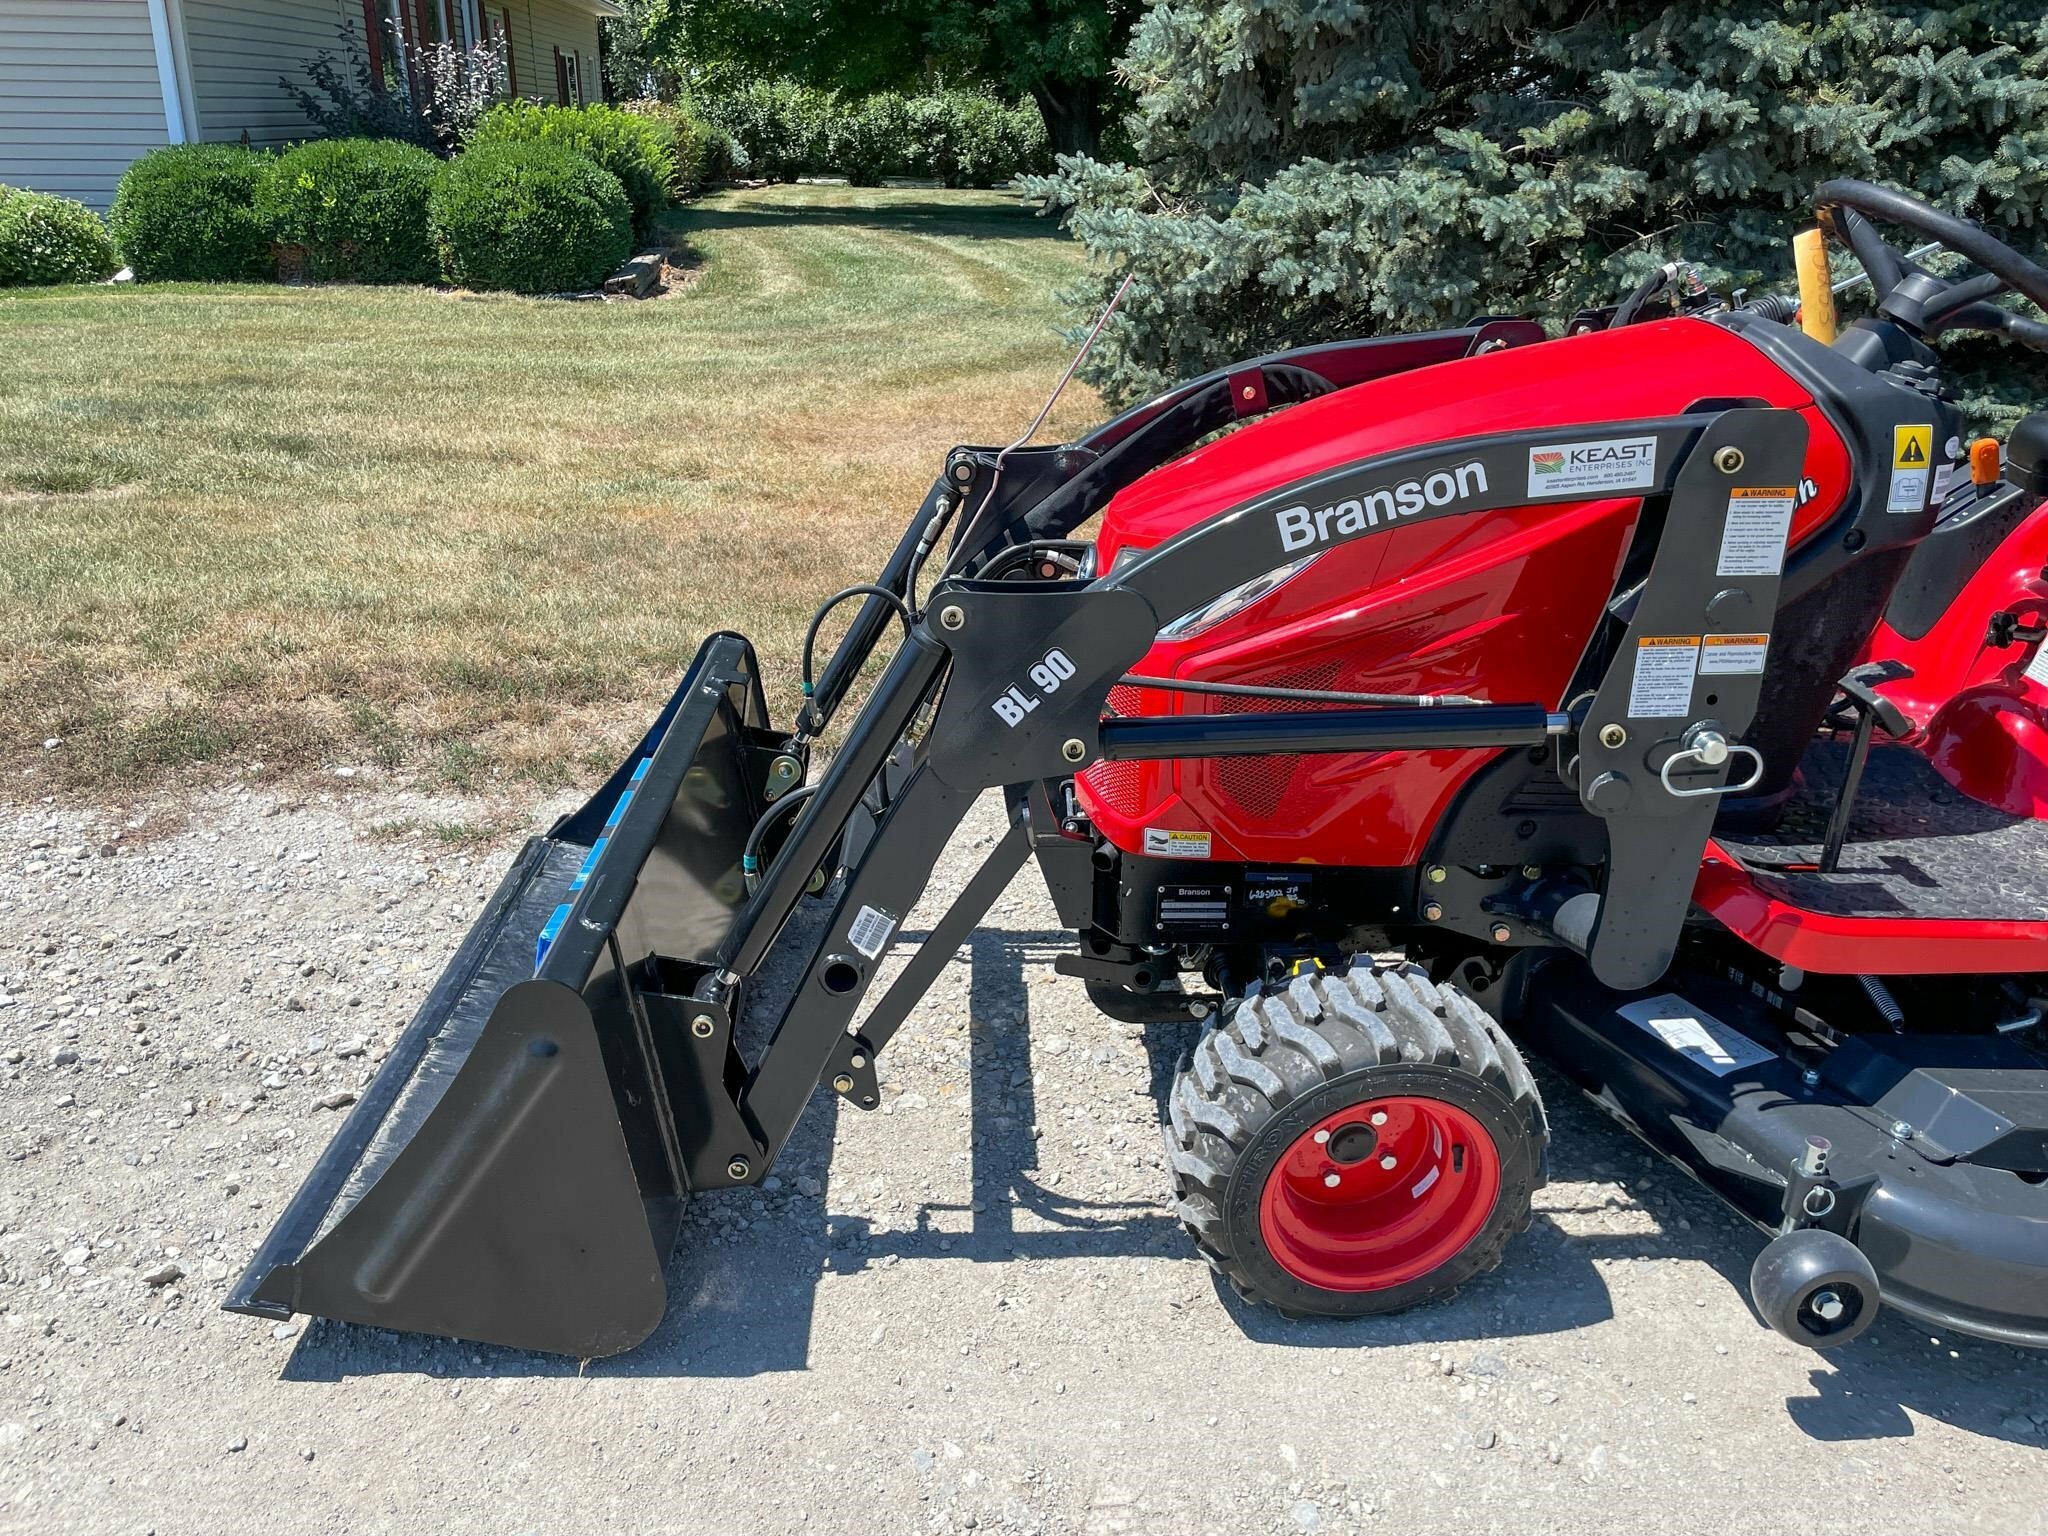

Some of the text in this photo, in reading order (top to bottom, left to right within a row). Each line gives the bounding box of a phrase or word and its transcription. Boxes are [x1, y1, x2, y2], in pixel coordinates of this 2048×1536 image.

[1570, 443, 1653, 464] KEAST
[1569, 458, 1652, 473] ENTERPRISES INC
[1749, 489, 1787, 497] WARNING
[1275, 461, 1489, 552] Branson
[1656, 638, 1692, 646] WARNING
[1723, 637, 1759, 645] WARNING
[991, 650, 1077, 729] BL 90
[1179, 833, 1208, 842] CAUTION
[1178, 888, 1211, 896] Branson
